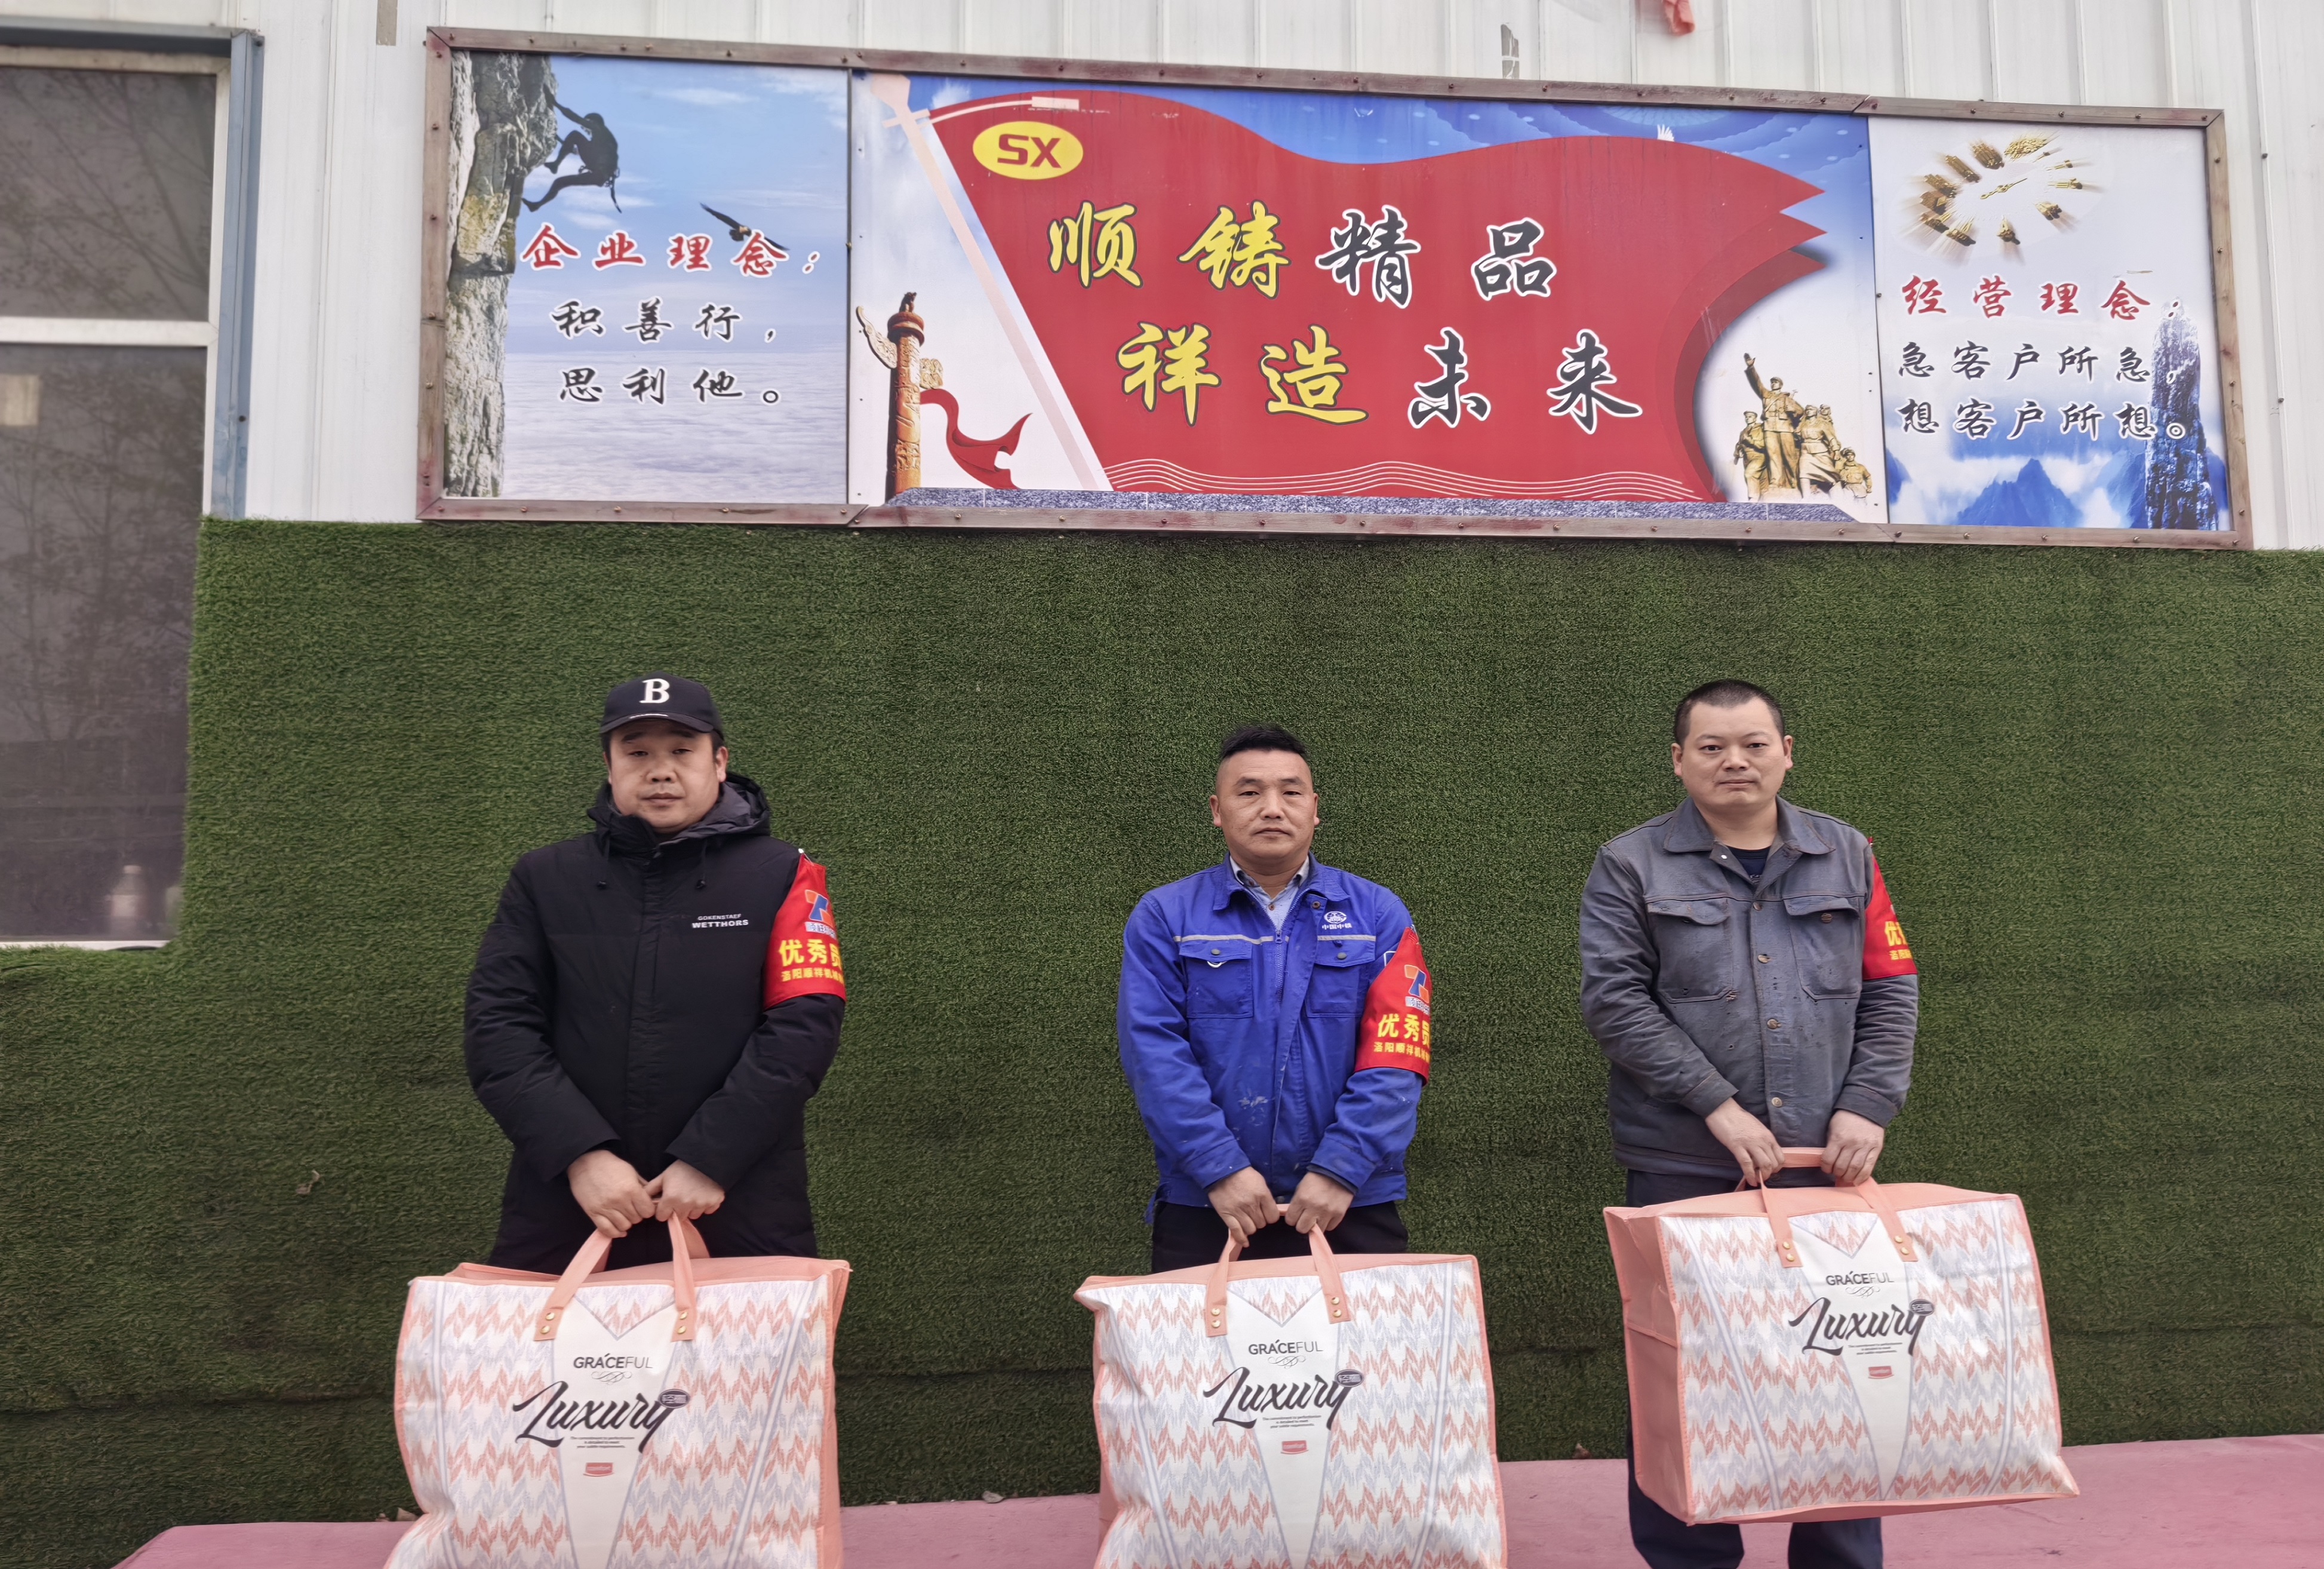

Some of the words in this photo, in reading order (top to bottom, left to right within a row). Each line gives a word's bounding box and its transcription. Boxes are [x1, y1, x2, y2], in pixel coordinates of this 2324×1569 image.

[997, 134, 1062, 168] SX
[1047, 199, 1556, 308] 顺铸精品
[1117, 323, 1643, 434] 祥造未来
[640, 678, 670, 704] B
[1788, 1297, 1926, 1356] Luxury
[512, 1381, 675, 1454] Luxury
[1203, 1367, 1353, 1430] Luxury
